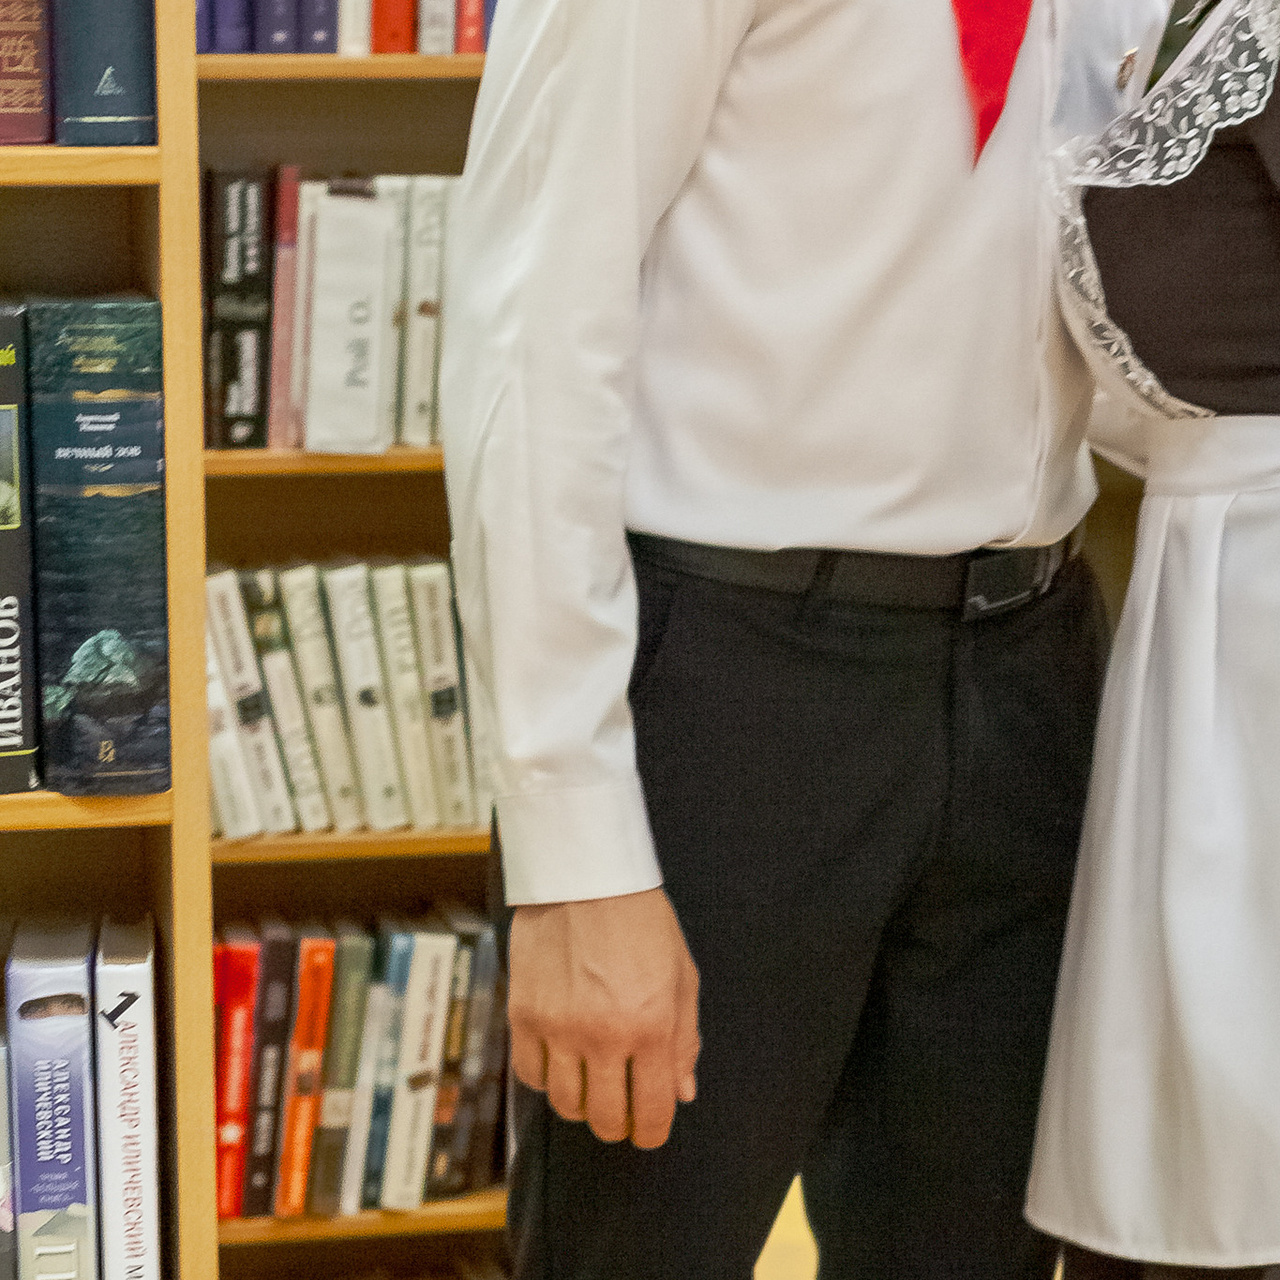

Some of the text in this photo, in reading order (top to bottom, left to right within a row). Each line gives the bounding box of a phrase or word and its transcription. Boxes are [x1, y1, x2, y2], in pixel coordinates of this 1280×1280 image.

[51, 1058, 73, 1165] АЛЕКСАНДР
[117, 1020, 141, 1130] АЛЕКСАНДР
[121, 1133, 148, 1260] ИЛИЧЕВСКИЙ
